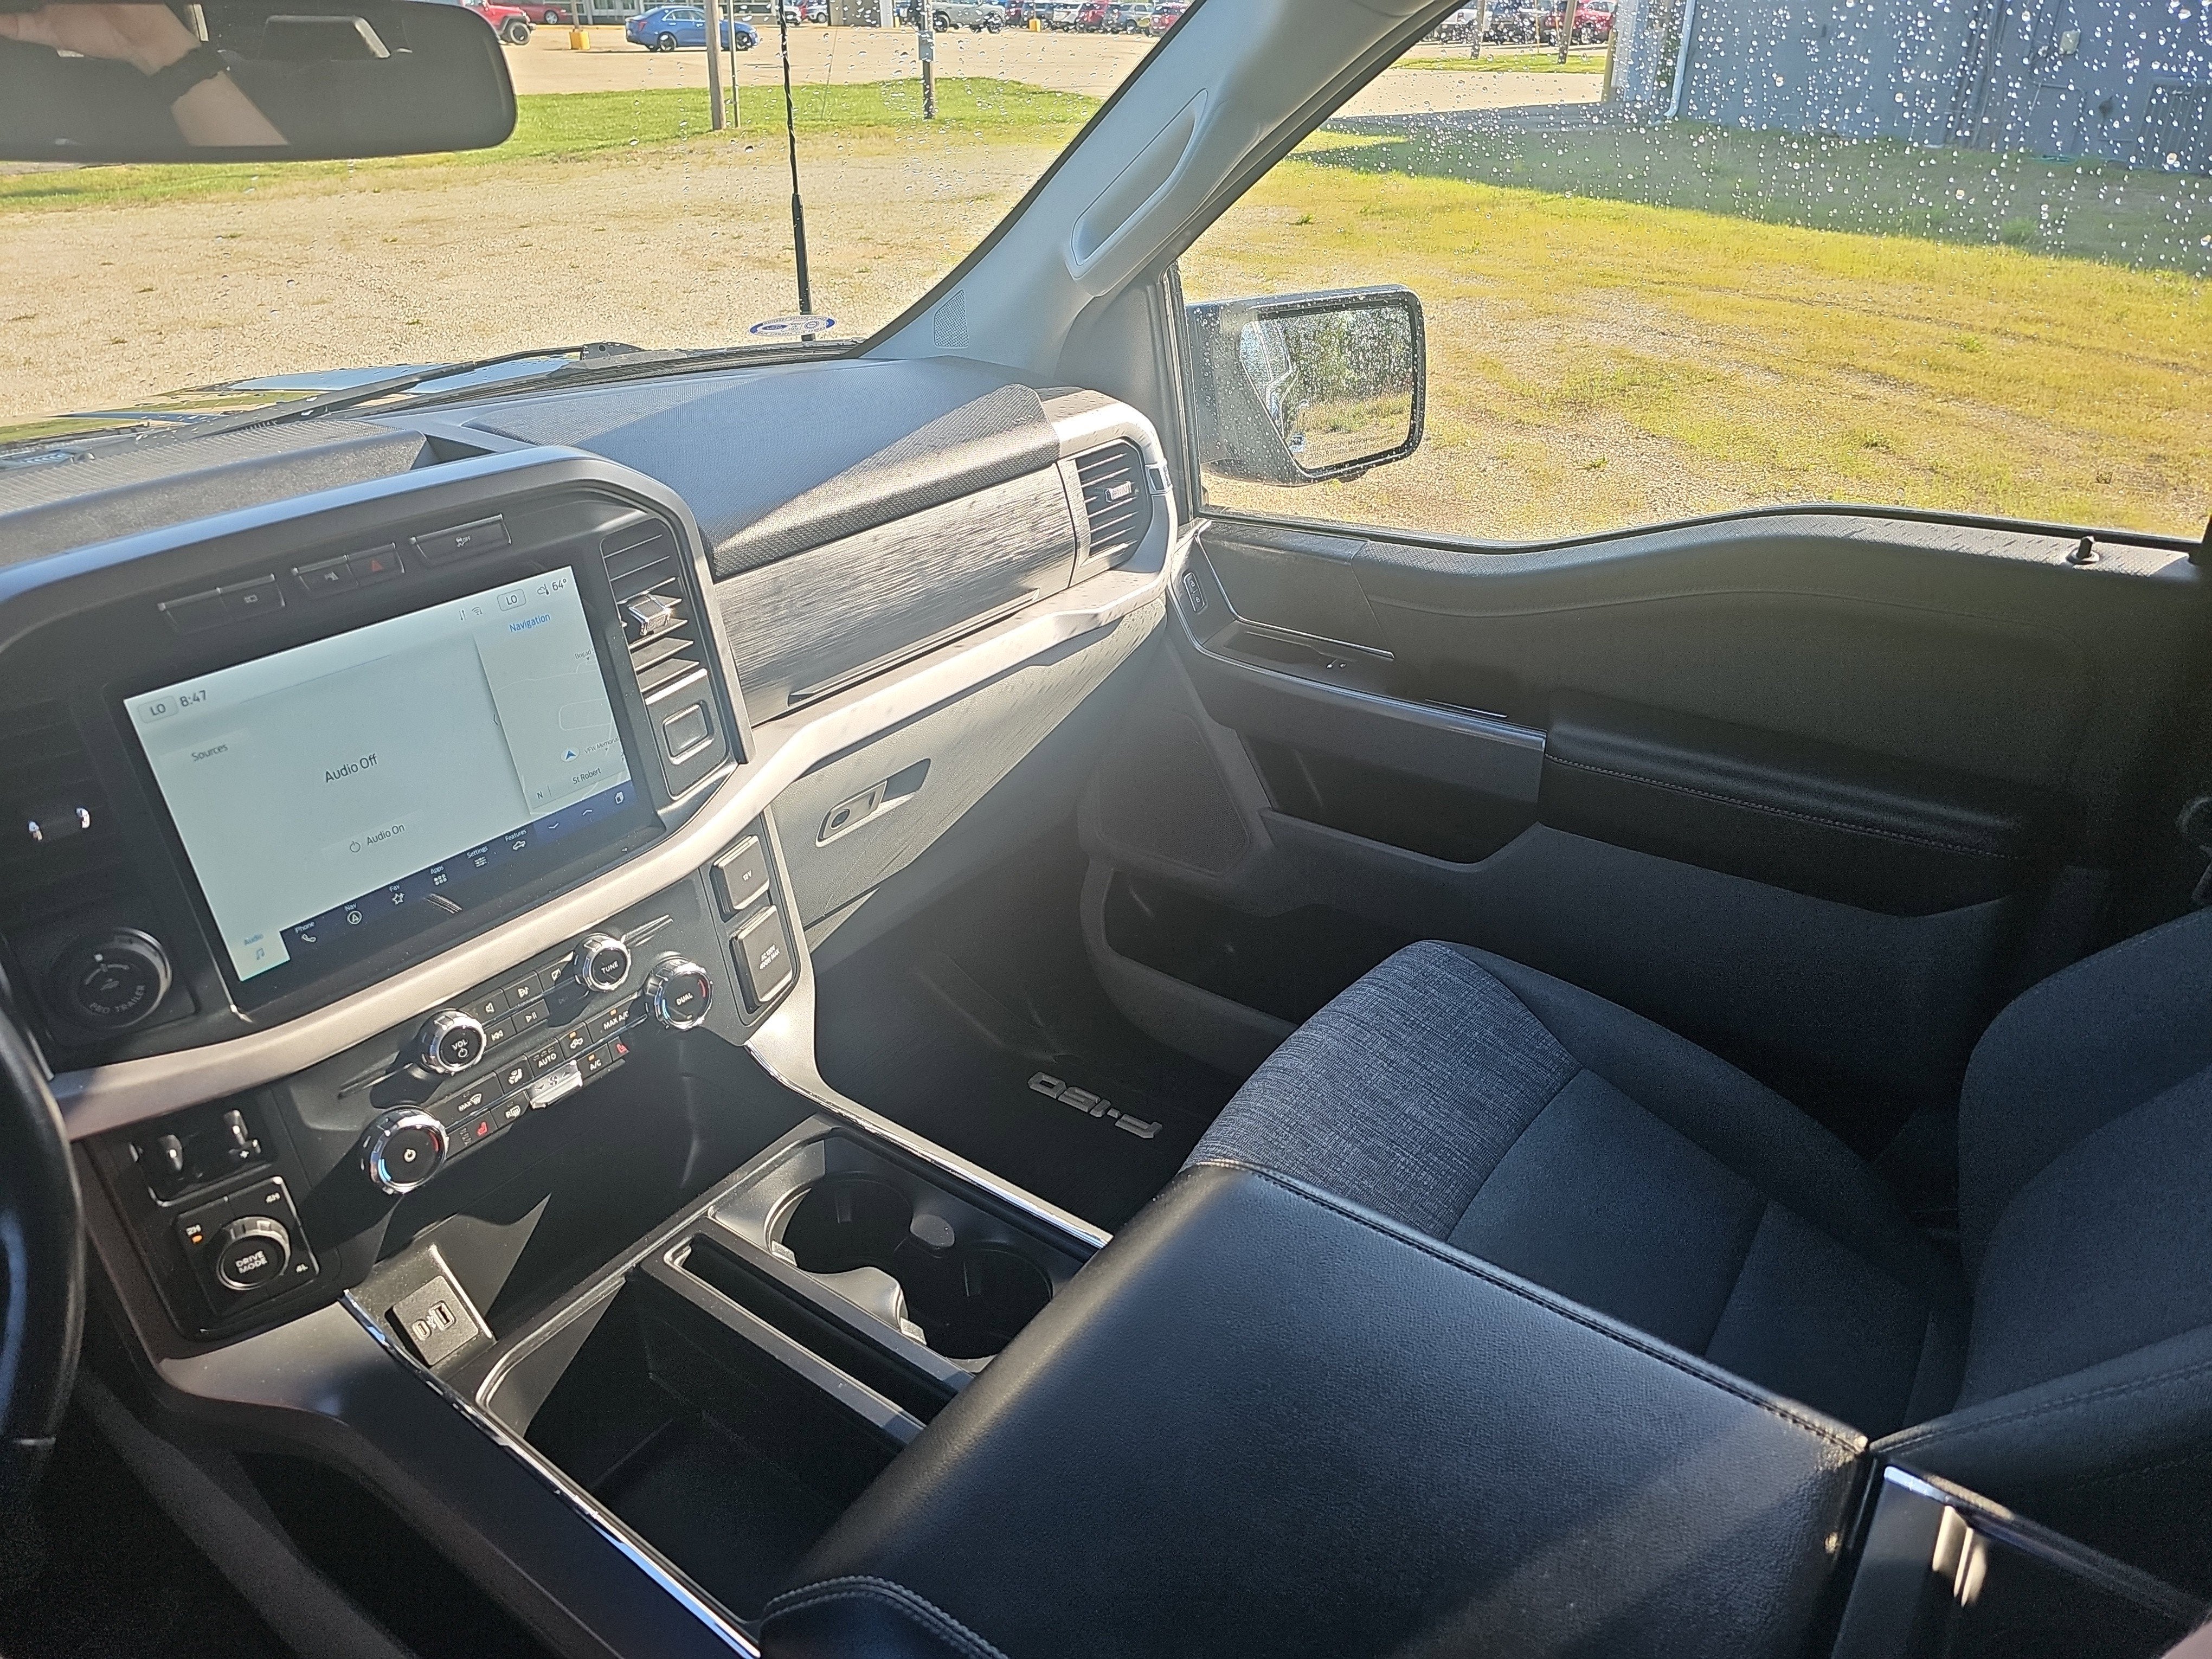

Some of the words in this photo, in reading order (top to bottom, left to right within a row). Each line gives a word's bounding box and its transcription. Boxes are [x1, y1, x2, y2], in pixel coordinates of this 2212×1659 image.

[506, 595, 518, 606] LO
[509, 613, 551, 633] Navigation
[150, 704, 166, 716] LO
[180, 690, 207, 707] 8:47
[191, 744, 229, 761] Sources
[584, 744, 597, 755] VFW
[325, 763, 359, 783] Audio
[359, 753, 378, 769] Off
[572, 775, 581, 785] St
[580, 767, 602, 781] Robert
[537, 791, 543, 800] N
[366, 830, 391, 846] Audio
[391, 824, 405, 835] On
[504, 828, 528, 841] Features
[466, 845, 488, 859] Settings
[430, 865, 445, 875] Apps
[389, 884, 400, 892] Fav
[344, 903, 357, 912] Nav
[294, 921, 316, 934] Phone
[244, 933, 265, 946] Audio
[601, 960, 619, 974] TUNE
[114, 985, 145, 1012] TRAILER
[677, 992, 693, 1006] DUAL
[603, 1019, 619, 1030] MAX
[618, 1011, 629, 1023] A/C
[452, 1039, 467, 1051] VOL
[538, 1053, 557, 1068] AUTO
[589, 1058, 602, 1071] A/C
[458, 1101, 472, 1112] MAX
[1028, 1071, 1162, 1139] F-150
[266, 1192, 280, 1203] 4H
[185, 1224, 201, 1236] 2H
[235, 1250, 265, 1268] DRIVE
[239, 1257, 268, 1274] MODE
[296, 1263, 309, 1272] 4L
